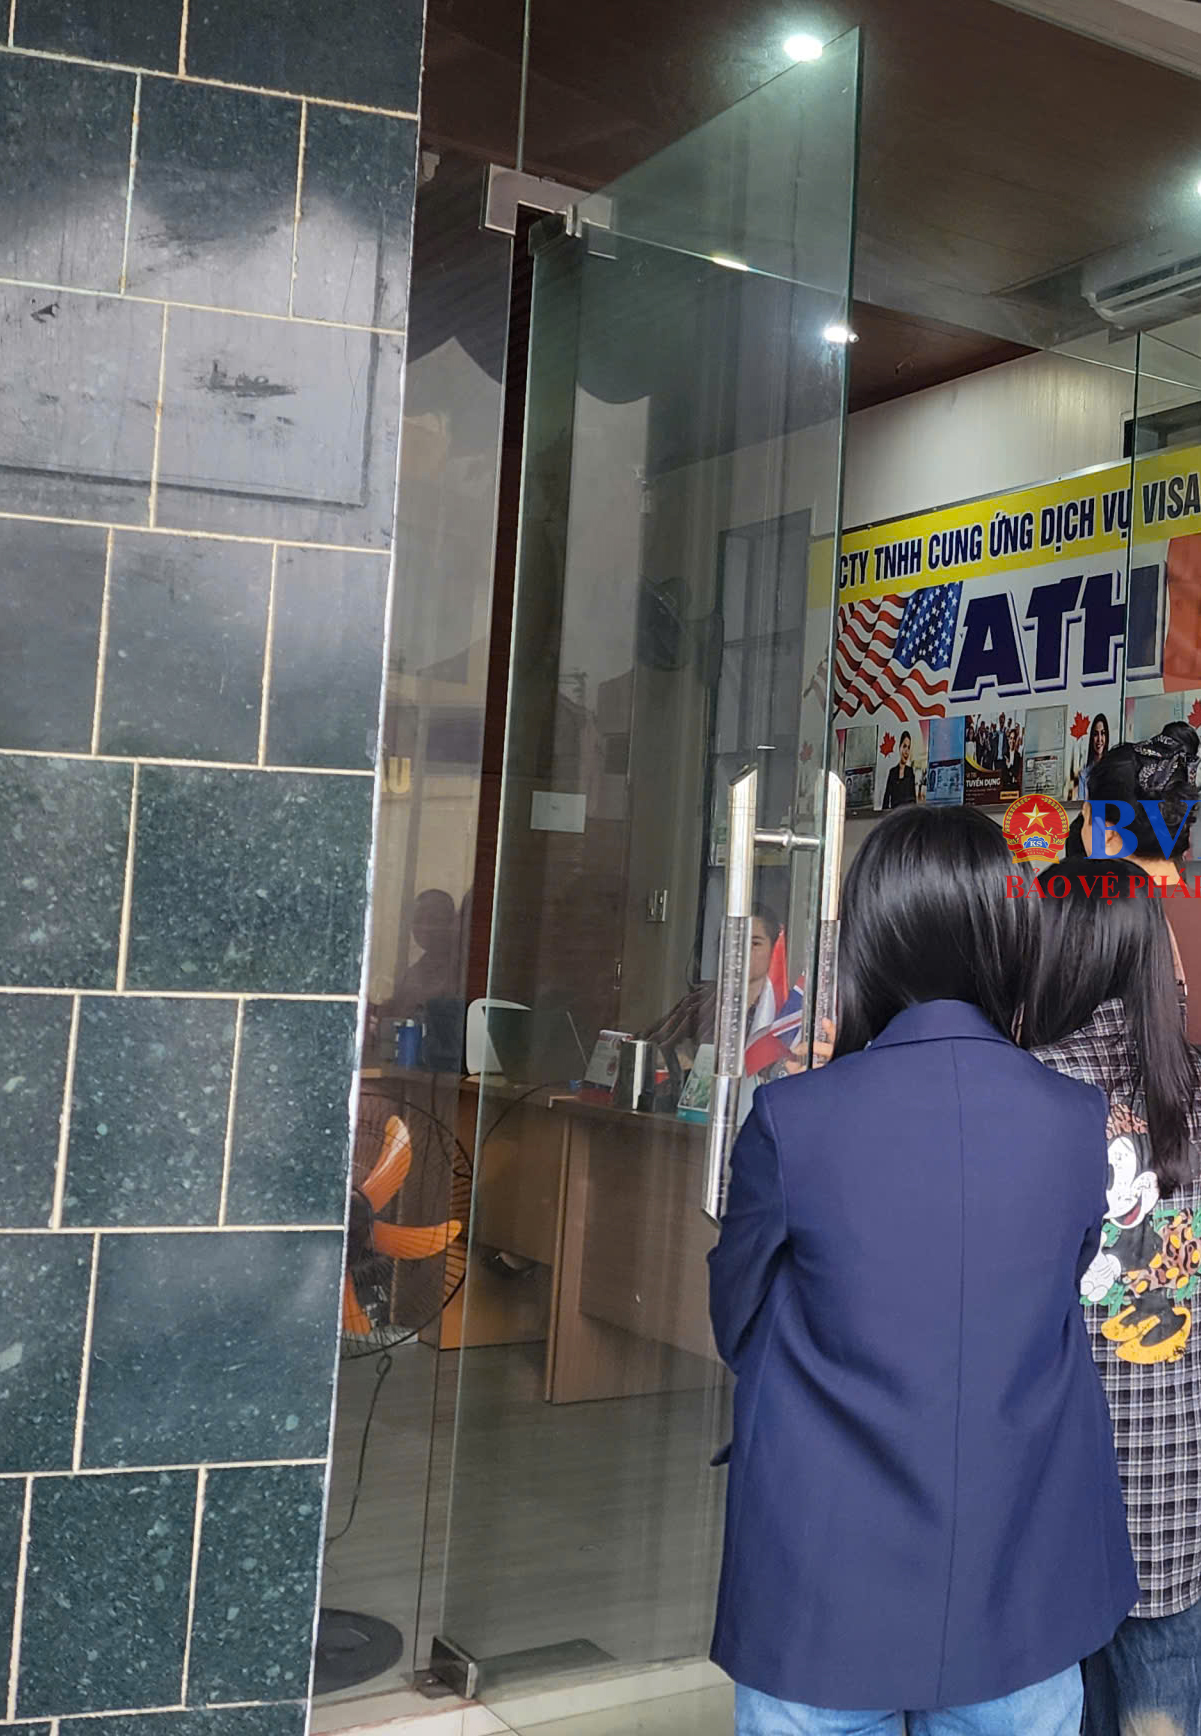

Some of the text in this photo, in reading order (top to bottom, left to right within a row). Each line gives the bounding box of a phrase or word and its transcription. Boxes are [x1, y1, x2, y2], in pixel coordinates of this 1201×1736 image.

[839, 549, 869, 589] CTY
[874, 538, 923, 581] TNHH
[928, 524, 983, 570] CUNG
[989, 512, 1034, 557] ỨNG
[1040, 498, 1095, 552] DỊCH
[1102, 488, 1131, 538] VỤ
[1142, 473, 1201, 525] VISA
